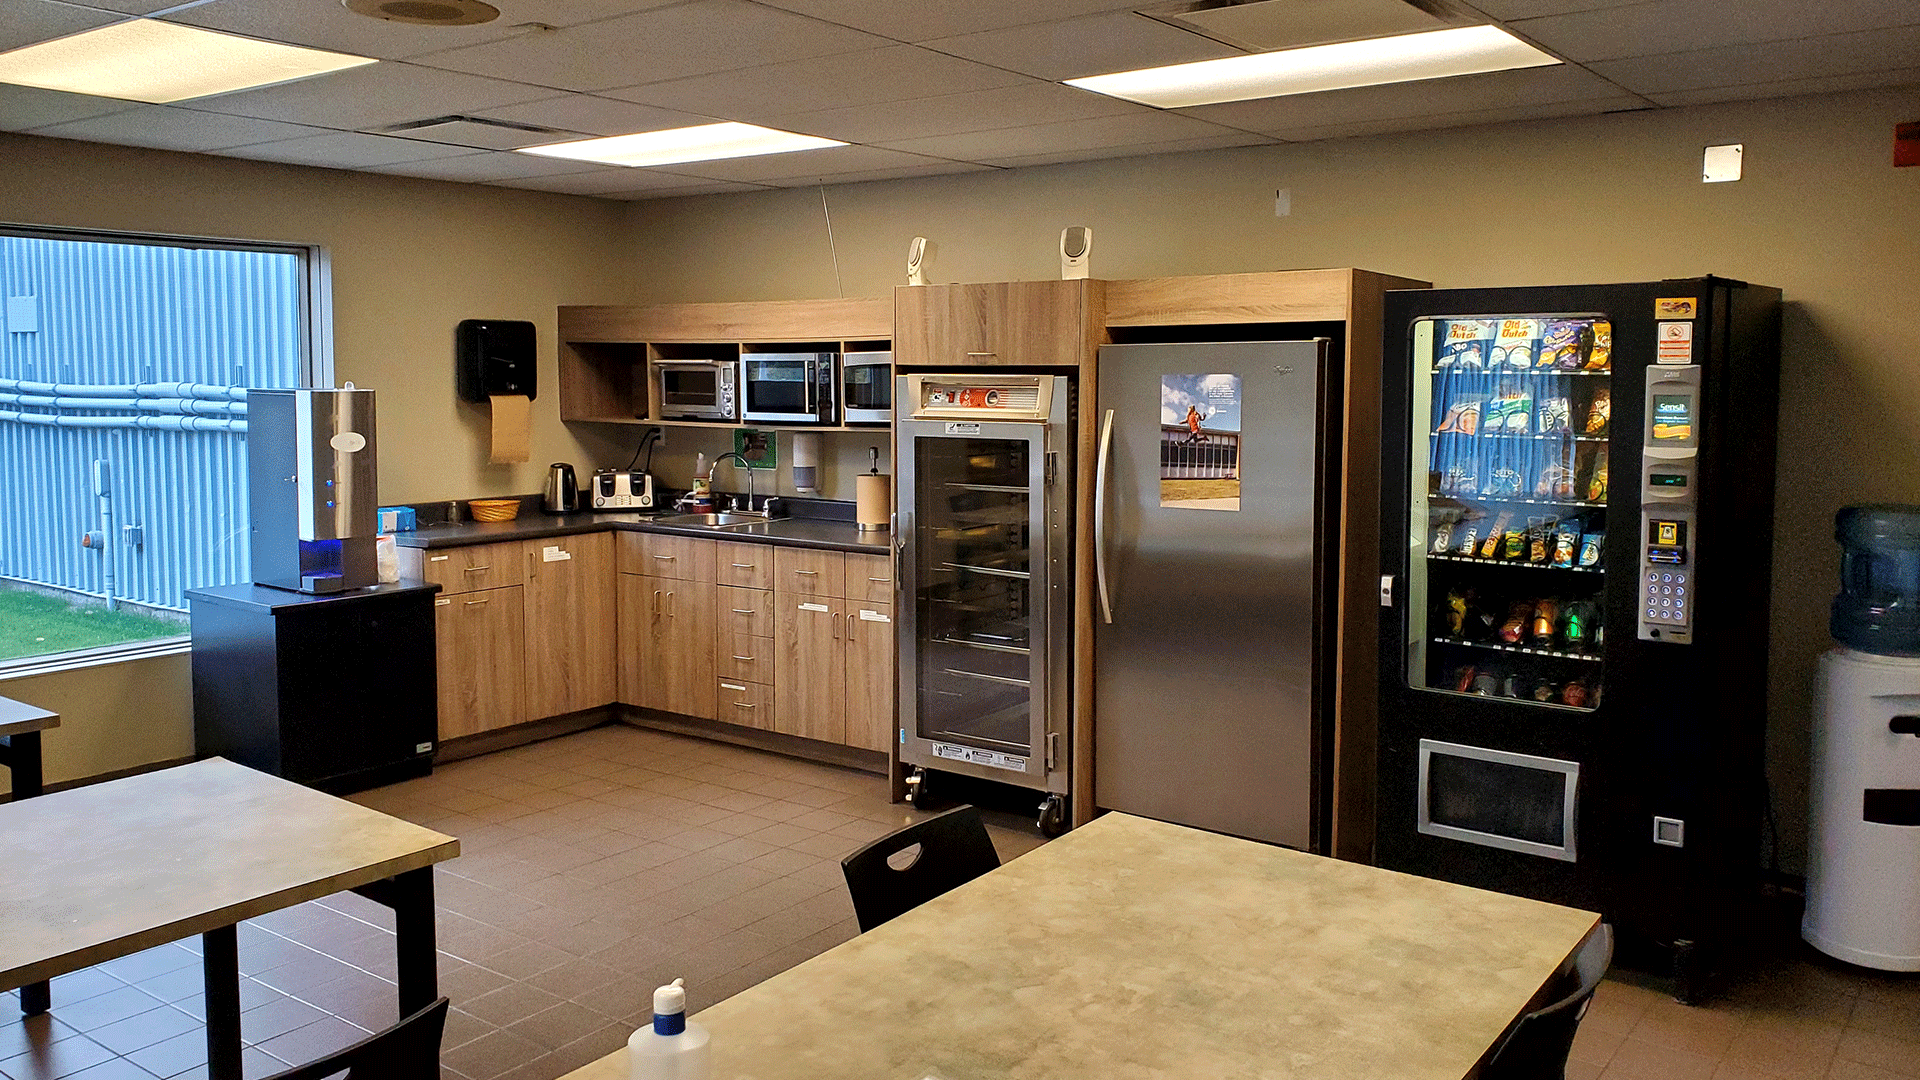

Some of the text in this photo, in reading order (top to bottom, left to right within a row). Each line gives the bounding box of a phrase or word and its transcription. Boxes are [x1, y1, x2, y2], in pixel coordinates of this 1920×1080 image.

[1451, 323, 1467, 331] Old
[1504, 320, 1520, 329] Old
[1502, 329, 1528, 338] Dutch
